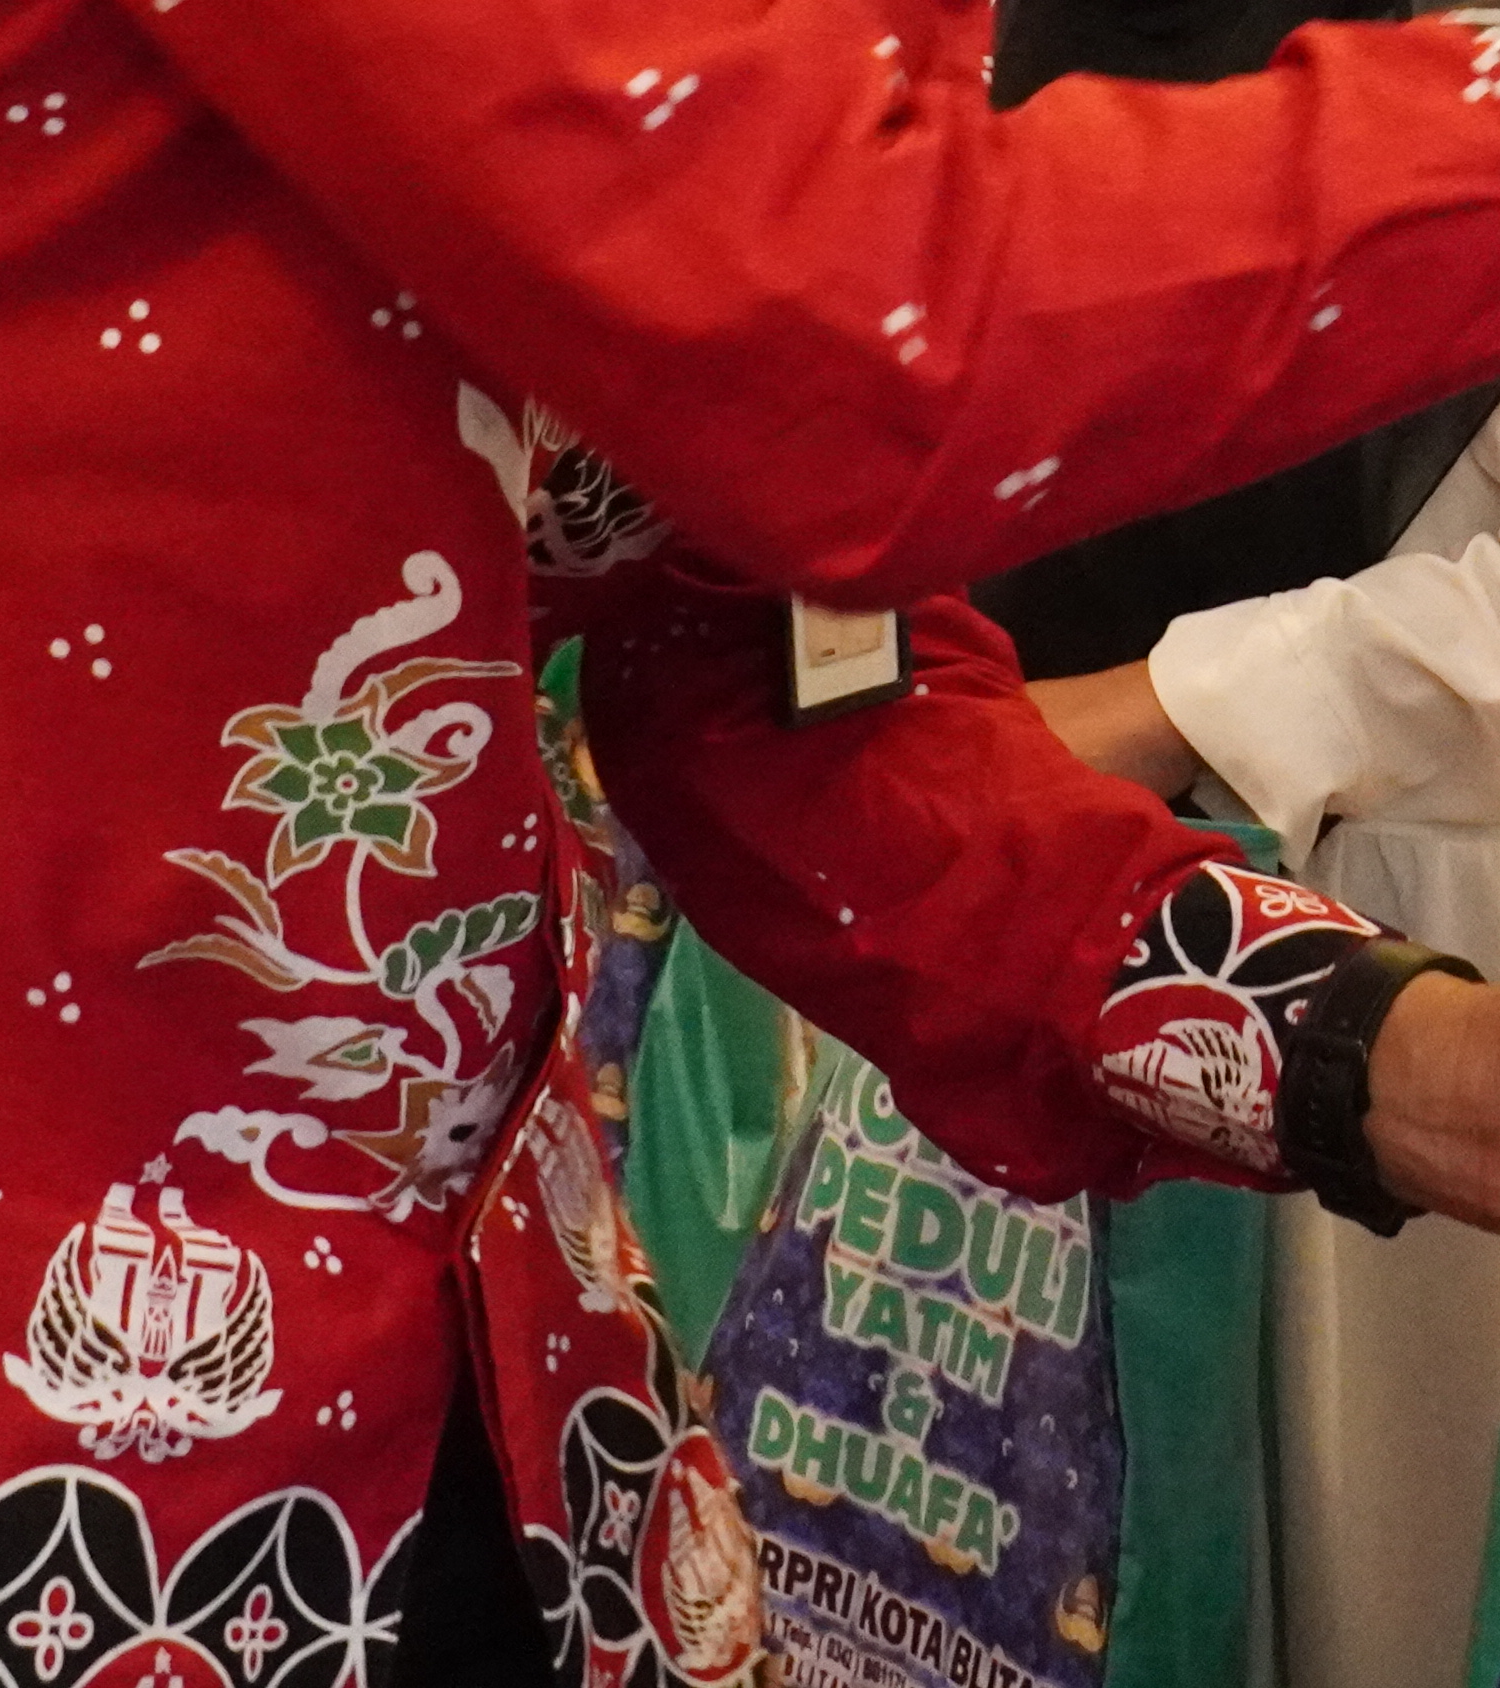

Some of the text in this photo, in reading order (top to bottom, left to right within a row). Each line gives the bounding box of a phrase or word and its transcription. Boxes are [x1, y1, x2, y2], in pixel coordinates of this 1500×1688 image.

[799, 1133, 1091, 1341] PEDULI
[828, 1262, 1014, 1402] YATIM
[890, 1369, 934, 1442] &
[858, 1583, 944, 1670] KOTA
